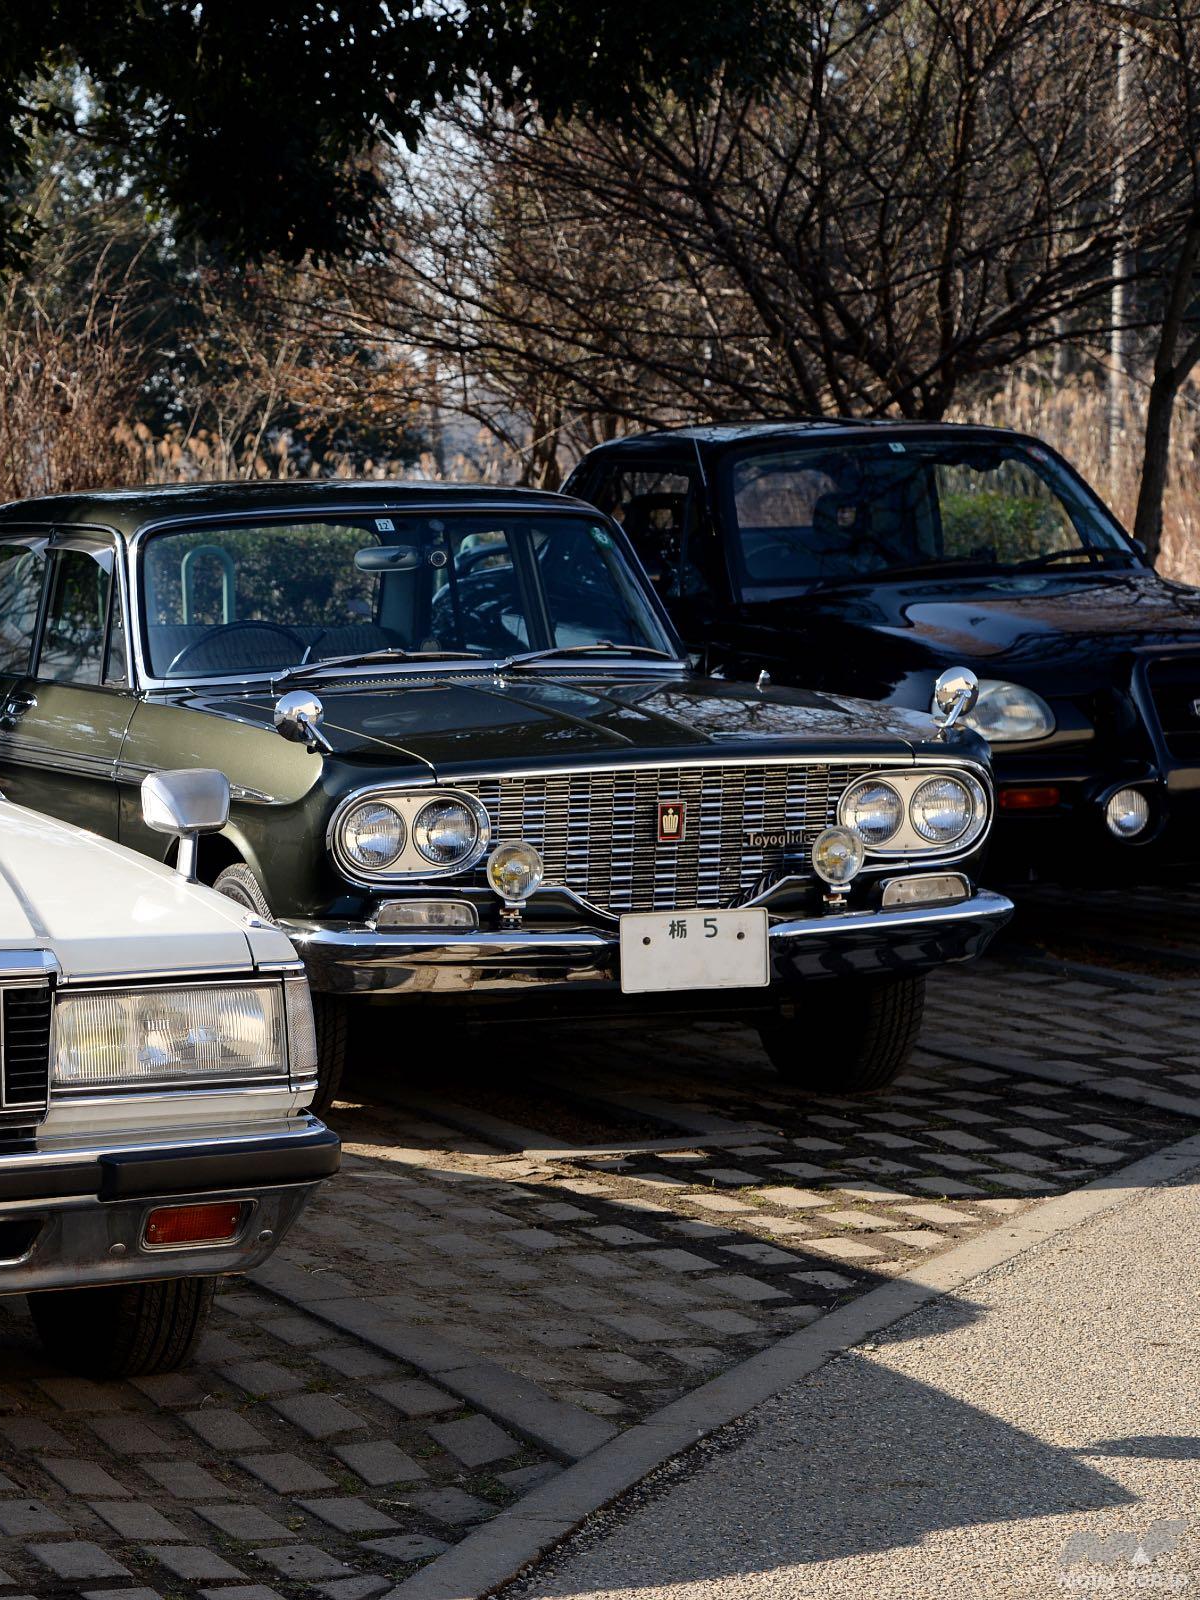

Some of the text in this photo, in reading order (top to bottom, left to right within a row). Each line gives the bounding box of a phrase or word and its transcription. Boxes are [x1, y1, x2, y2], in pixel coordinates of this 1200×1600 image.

[747, 830, 811, 849] Toyoglide
[668, 917, 719, 939] 栃 5
